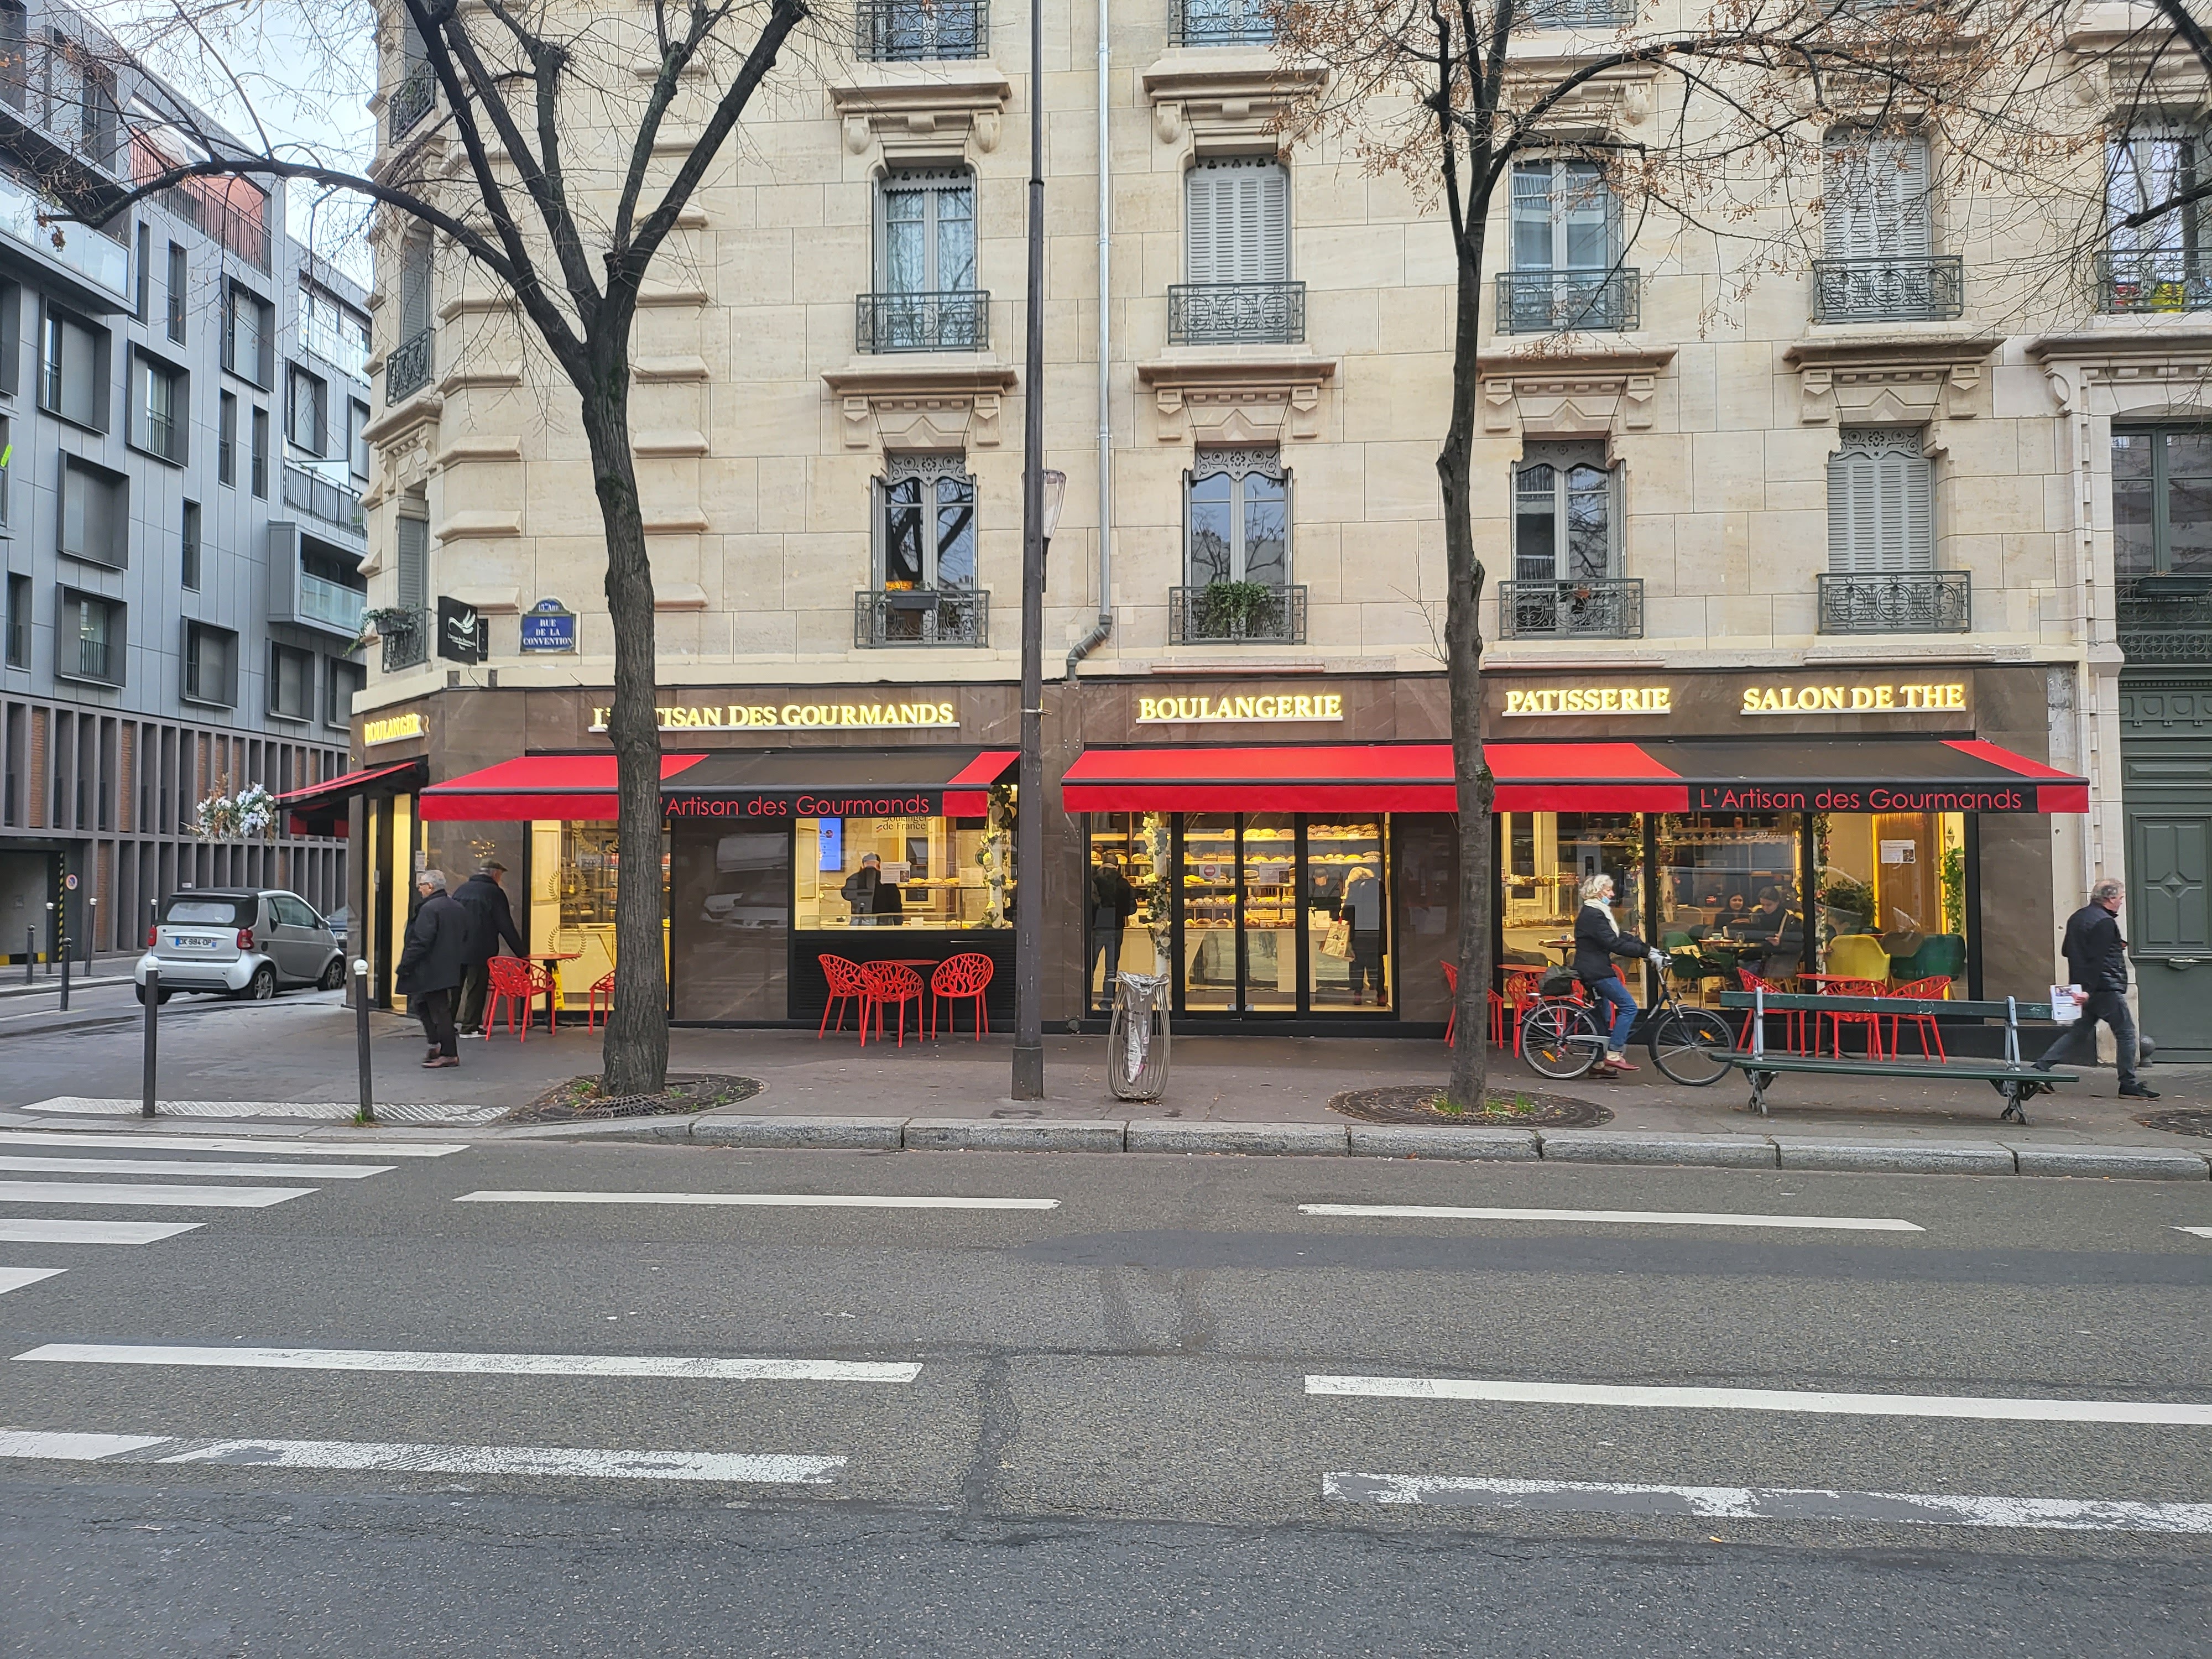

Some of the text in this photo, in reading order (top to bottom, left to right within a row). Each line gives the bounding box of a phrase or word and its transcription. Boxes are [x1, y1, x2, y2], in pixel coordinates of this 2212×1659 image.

[540, 619, 556, 627] RUE
[523, 637, 572, 645] CONVENTION
[1139, 695, 1342, 720] BOULANGERIE
[1505, 687, 1671, 713] PATISSERIE
[1743, 684, 1965, 711] SALON DE THE
[593, 703, 954, 728] L'ISAN DES GOURMANDS
[660, 794, 930, 816] 'Artisan des Gourmands
[1700, 787, 2022, 810] L'Artisan des Gourmands
[883, 822, 894, 830] de
